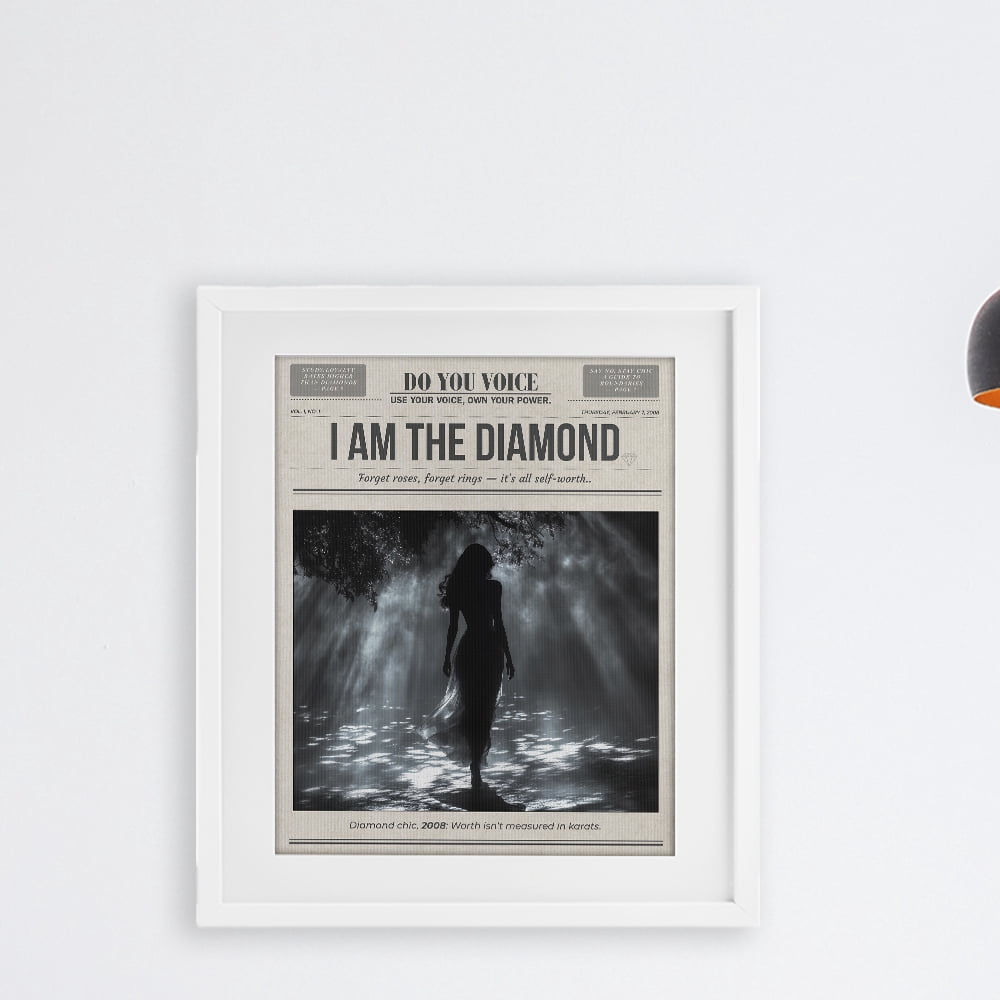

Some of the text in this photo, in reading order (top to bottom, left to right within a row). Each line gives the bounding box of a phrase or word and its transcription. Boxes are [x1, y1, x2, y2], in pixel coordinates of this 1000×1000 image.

[403, 372, 539, 392] DO YOU VOICE
[390, 396, 552, 406] USE YOUR VOICE, OWN YOUR POWER.
[330, 422, 620, 462] I AM THE DIAMOND
[358, 472, 391, 486] Forget
[392, 475, 421, 484] roses,
[424, 472, 456, 486] forget
[457, 473, 483, 486] rings
[500, 473, 517, 483] it's
[518, 473, 533, 483] all
[349, 821, 395, 830] Diamond
[451, 821, 481, 830] Worth
[483, 821, 504, 831] isn't
[505, 822, 555, 831] measured
[556, 823, 567, 831] in
[568, 822, 602, 831] karats.
